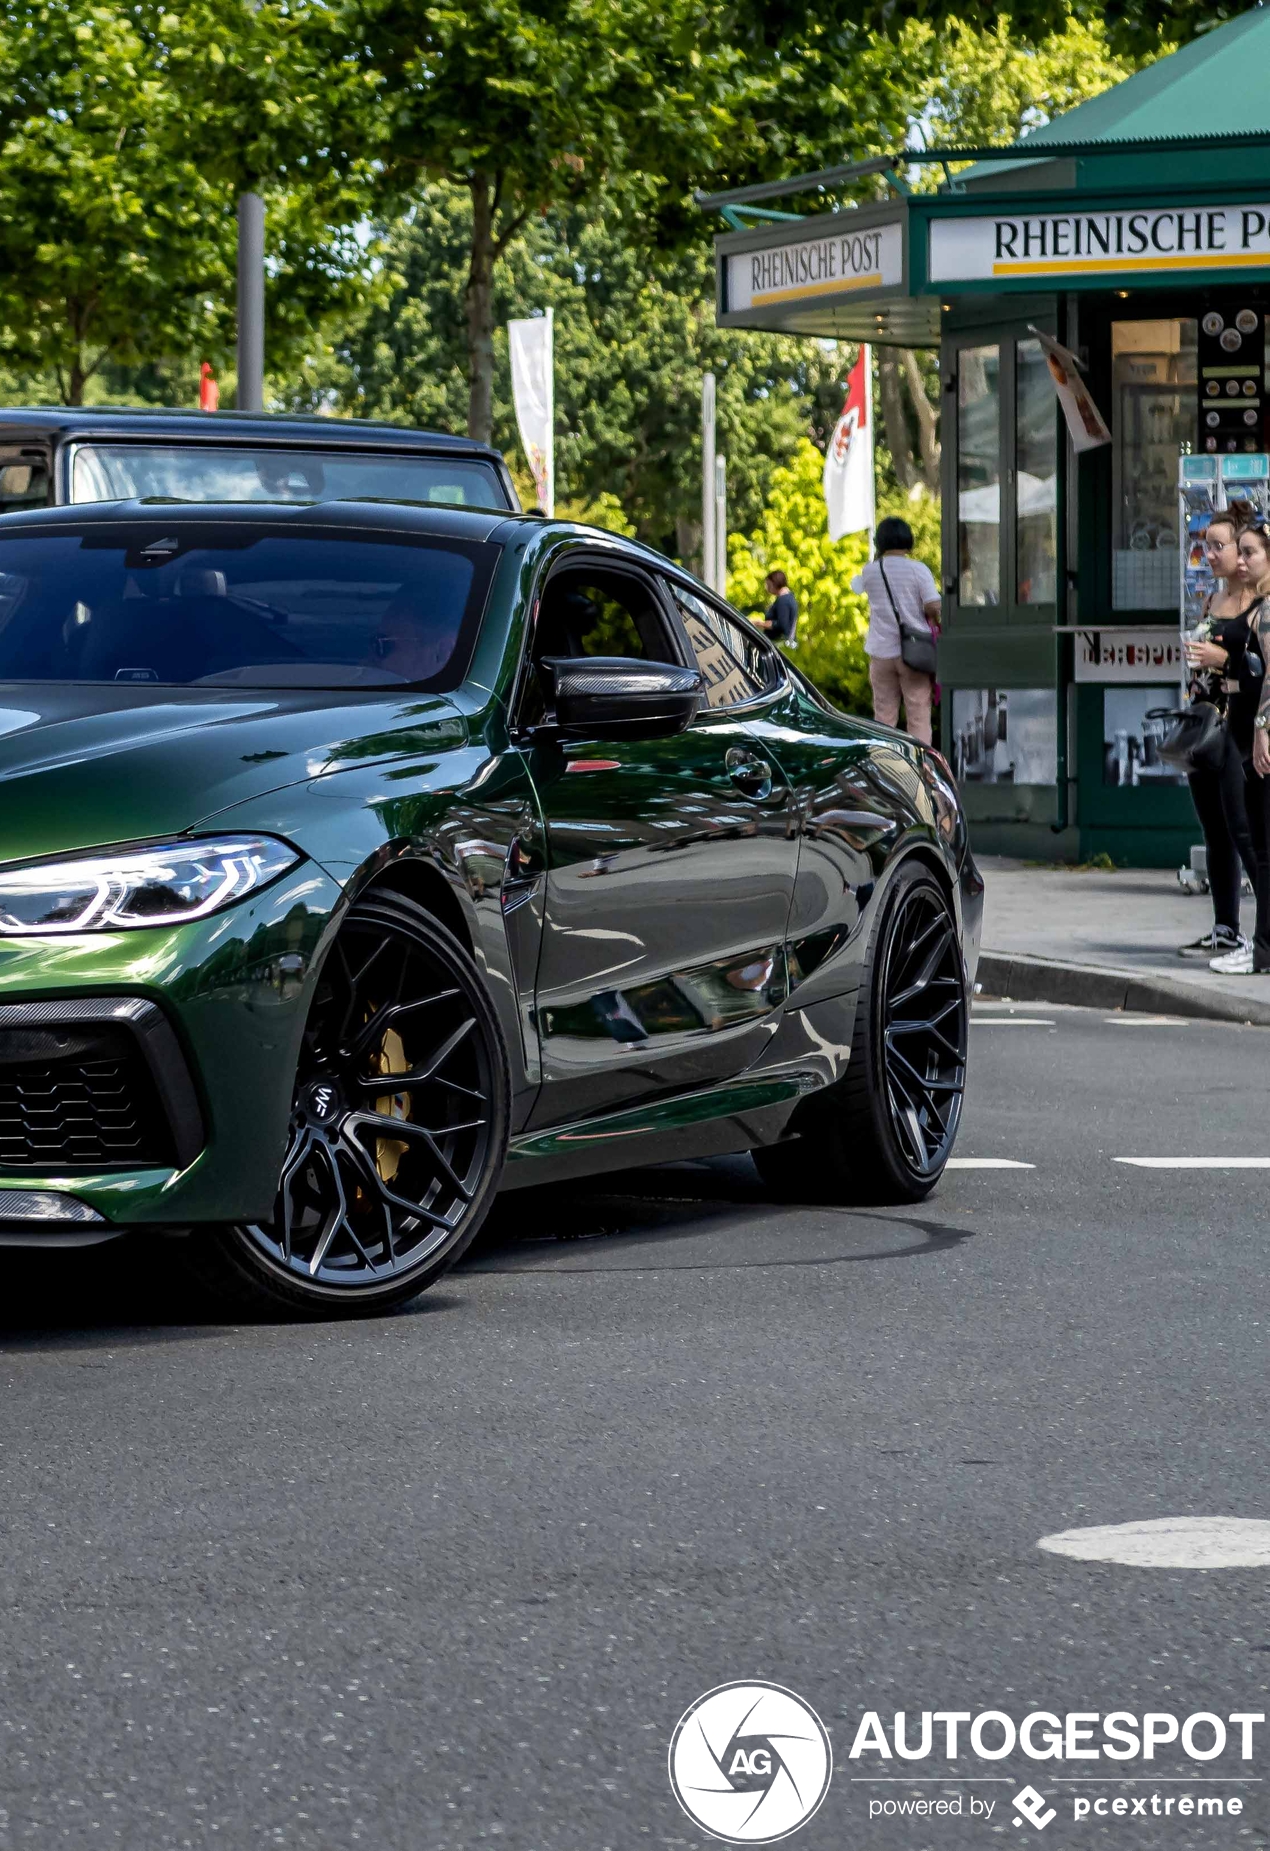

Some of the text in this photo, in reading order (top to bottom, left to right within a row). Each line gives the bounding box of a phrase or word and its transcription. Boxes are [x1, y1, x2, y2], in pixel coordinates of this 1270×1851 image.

[751, 231, 883, 292] RHEINISCHE POST
[994, 209, 1270, 259] RHEINISCHE P
